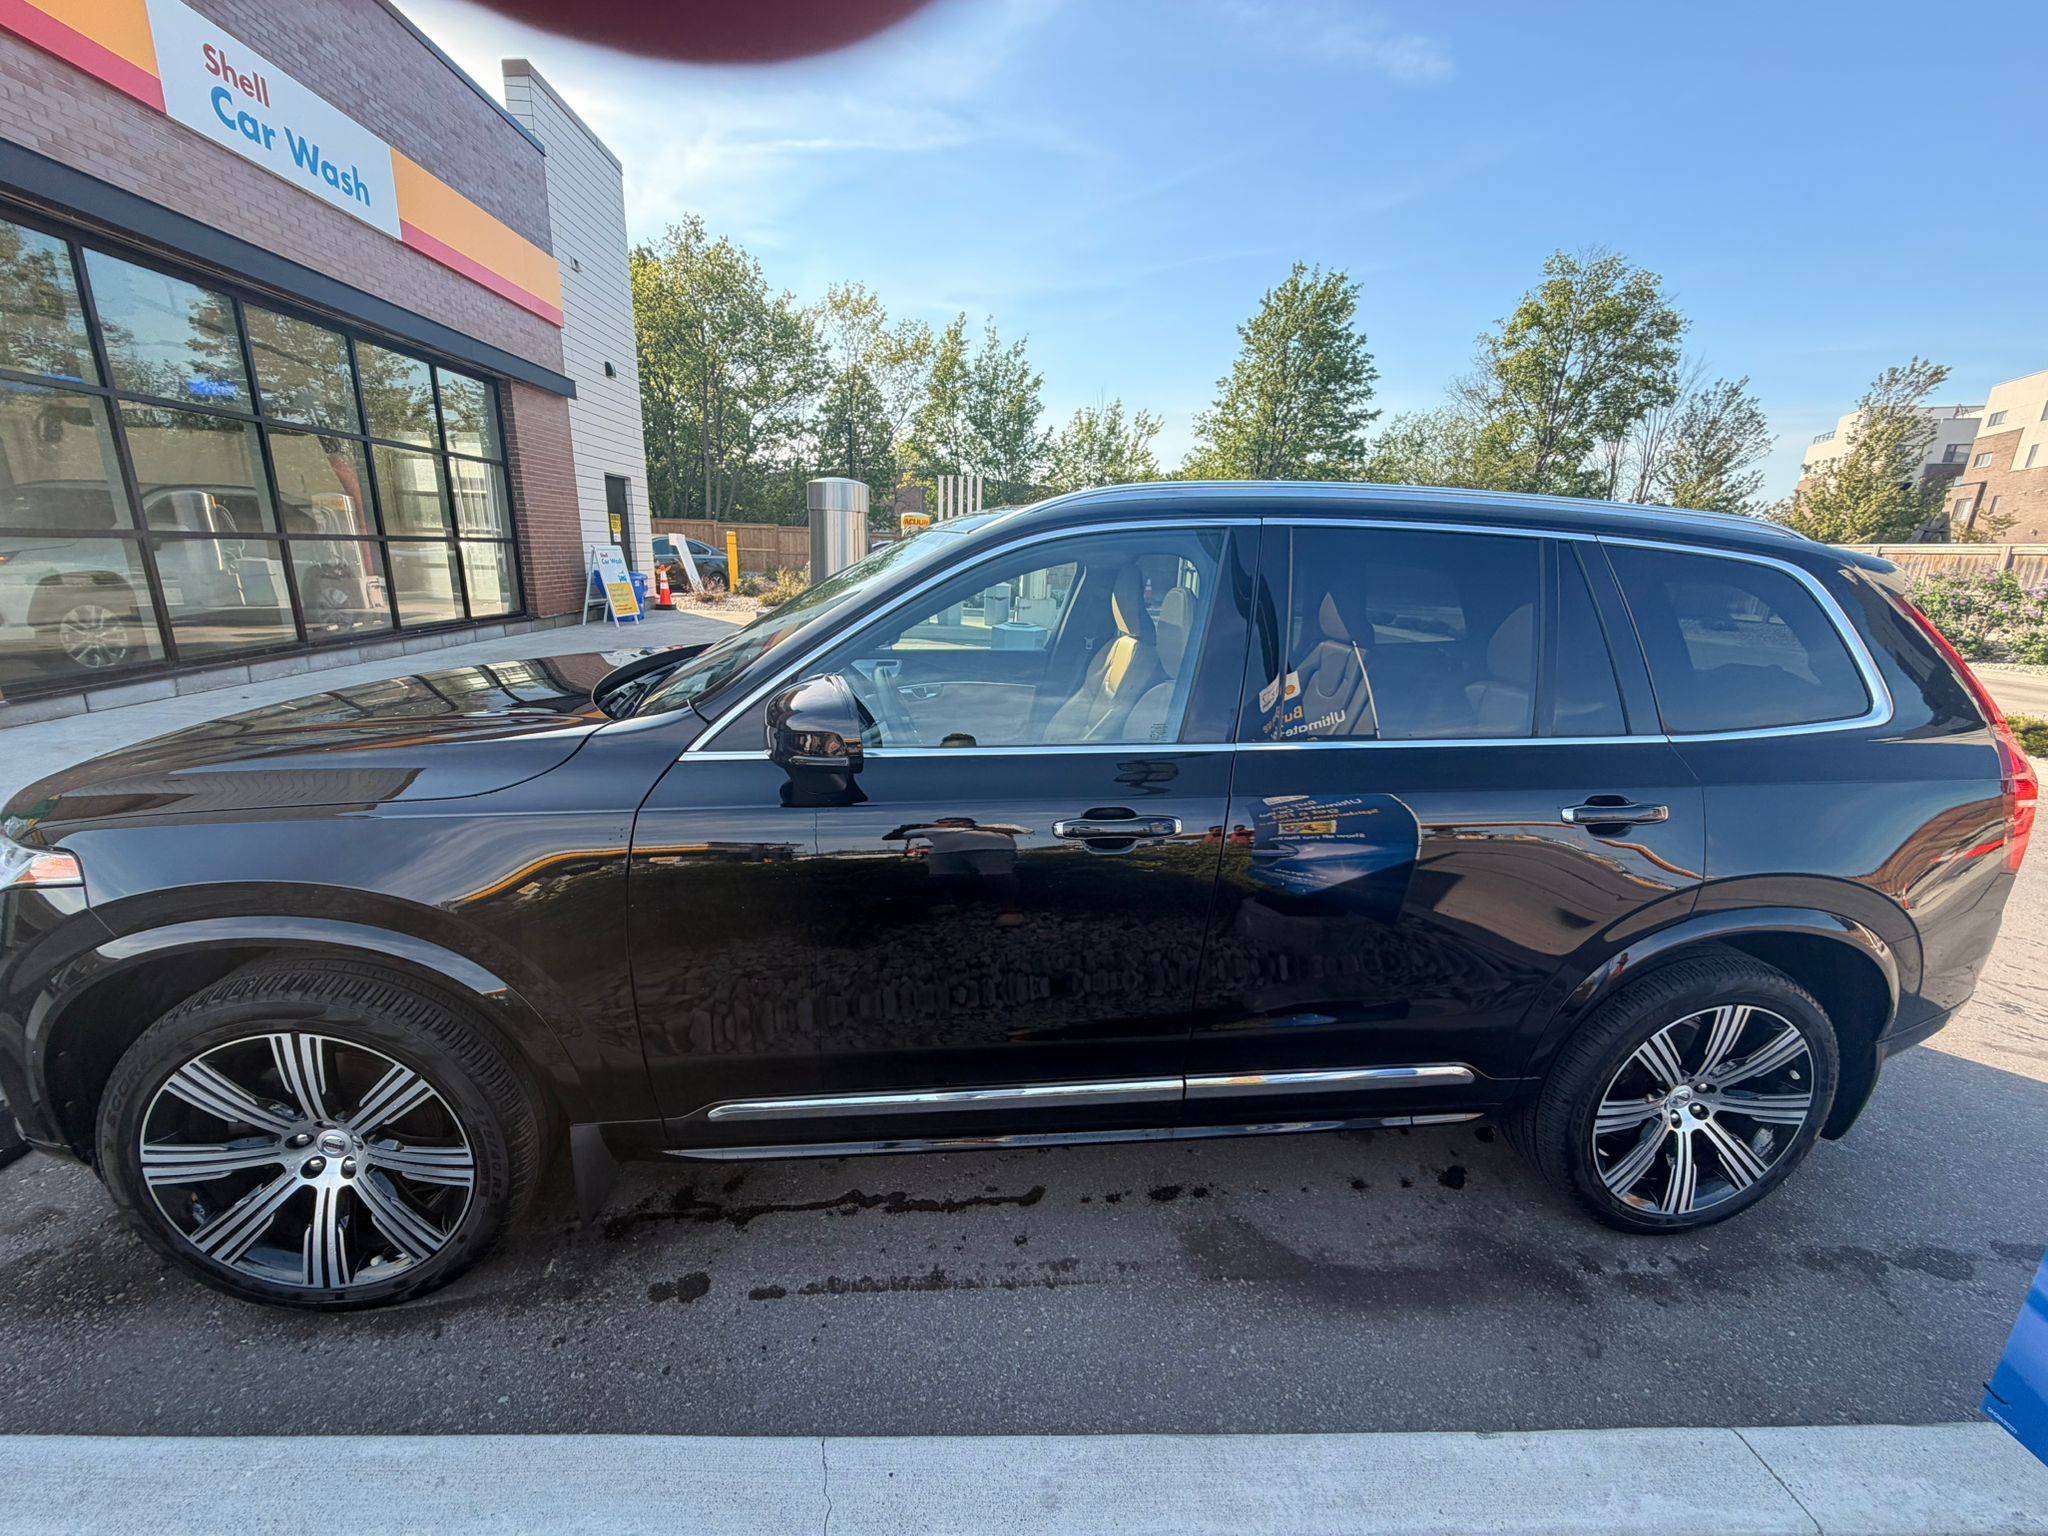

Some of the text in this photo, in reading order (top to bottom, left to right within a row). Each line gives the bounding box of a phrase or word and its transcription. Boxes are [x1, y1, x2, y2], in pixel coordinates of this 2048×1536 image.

[202, 43, 270, 108] Shell
[211, 86, 371, 207] Car Wash
